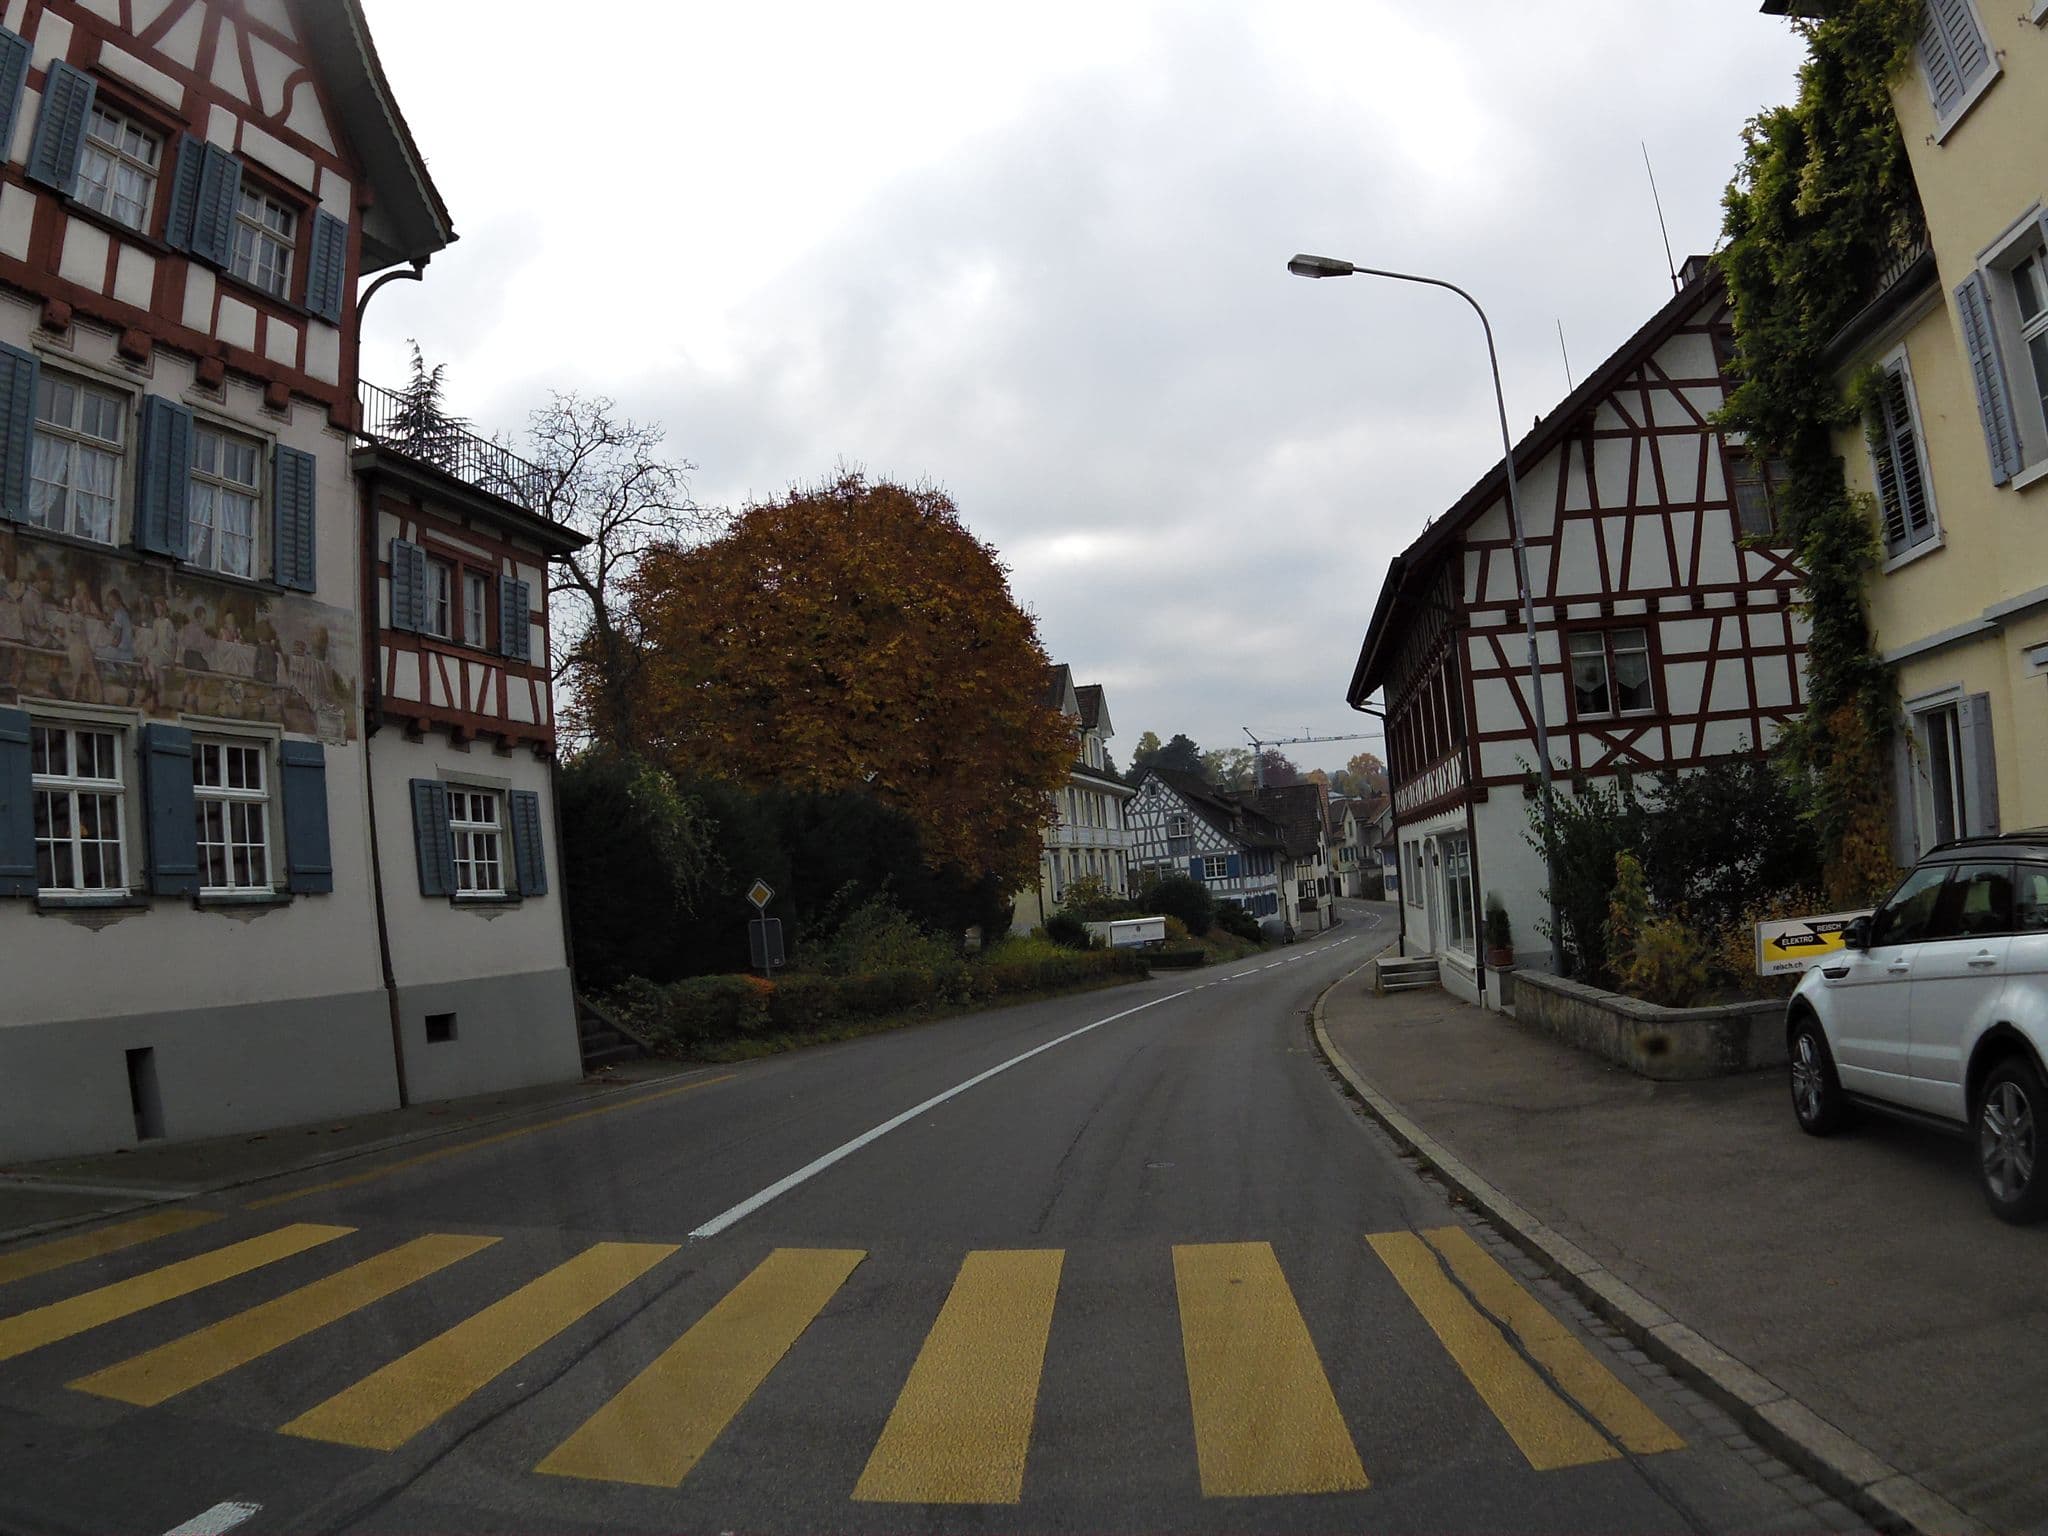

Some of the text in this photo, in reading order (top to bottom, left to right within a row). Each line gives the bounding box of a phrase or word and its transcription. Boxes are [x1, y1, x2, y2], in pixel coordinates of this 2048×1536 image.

[1816, 923, 1842, 932] REISCH
[1782, 935, 1814, 946] ELEKTRO
[1772, 961, 1804, 971] reisch.ch
